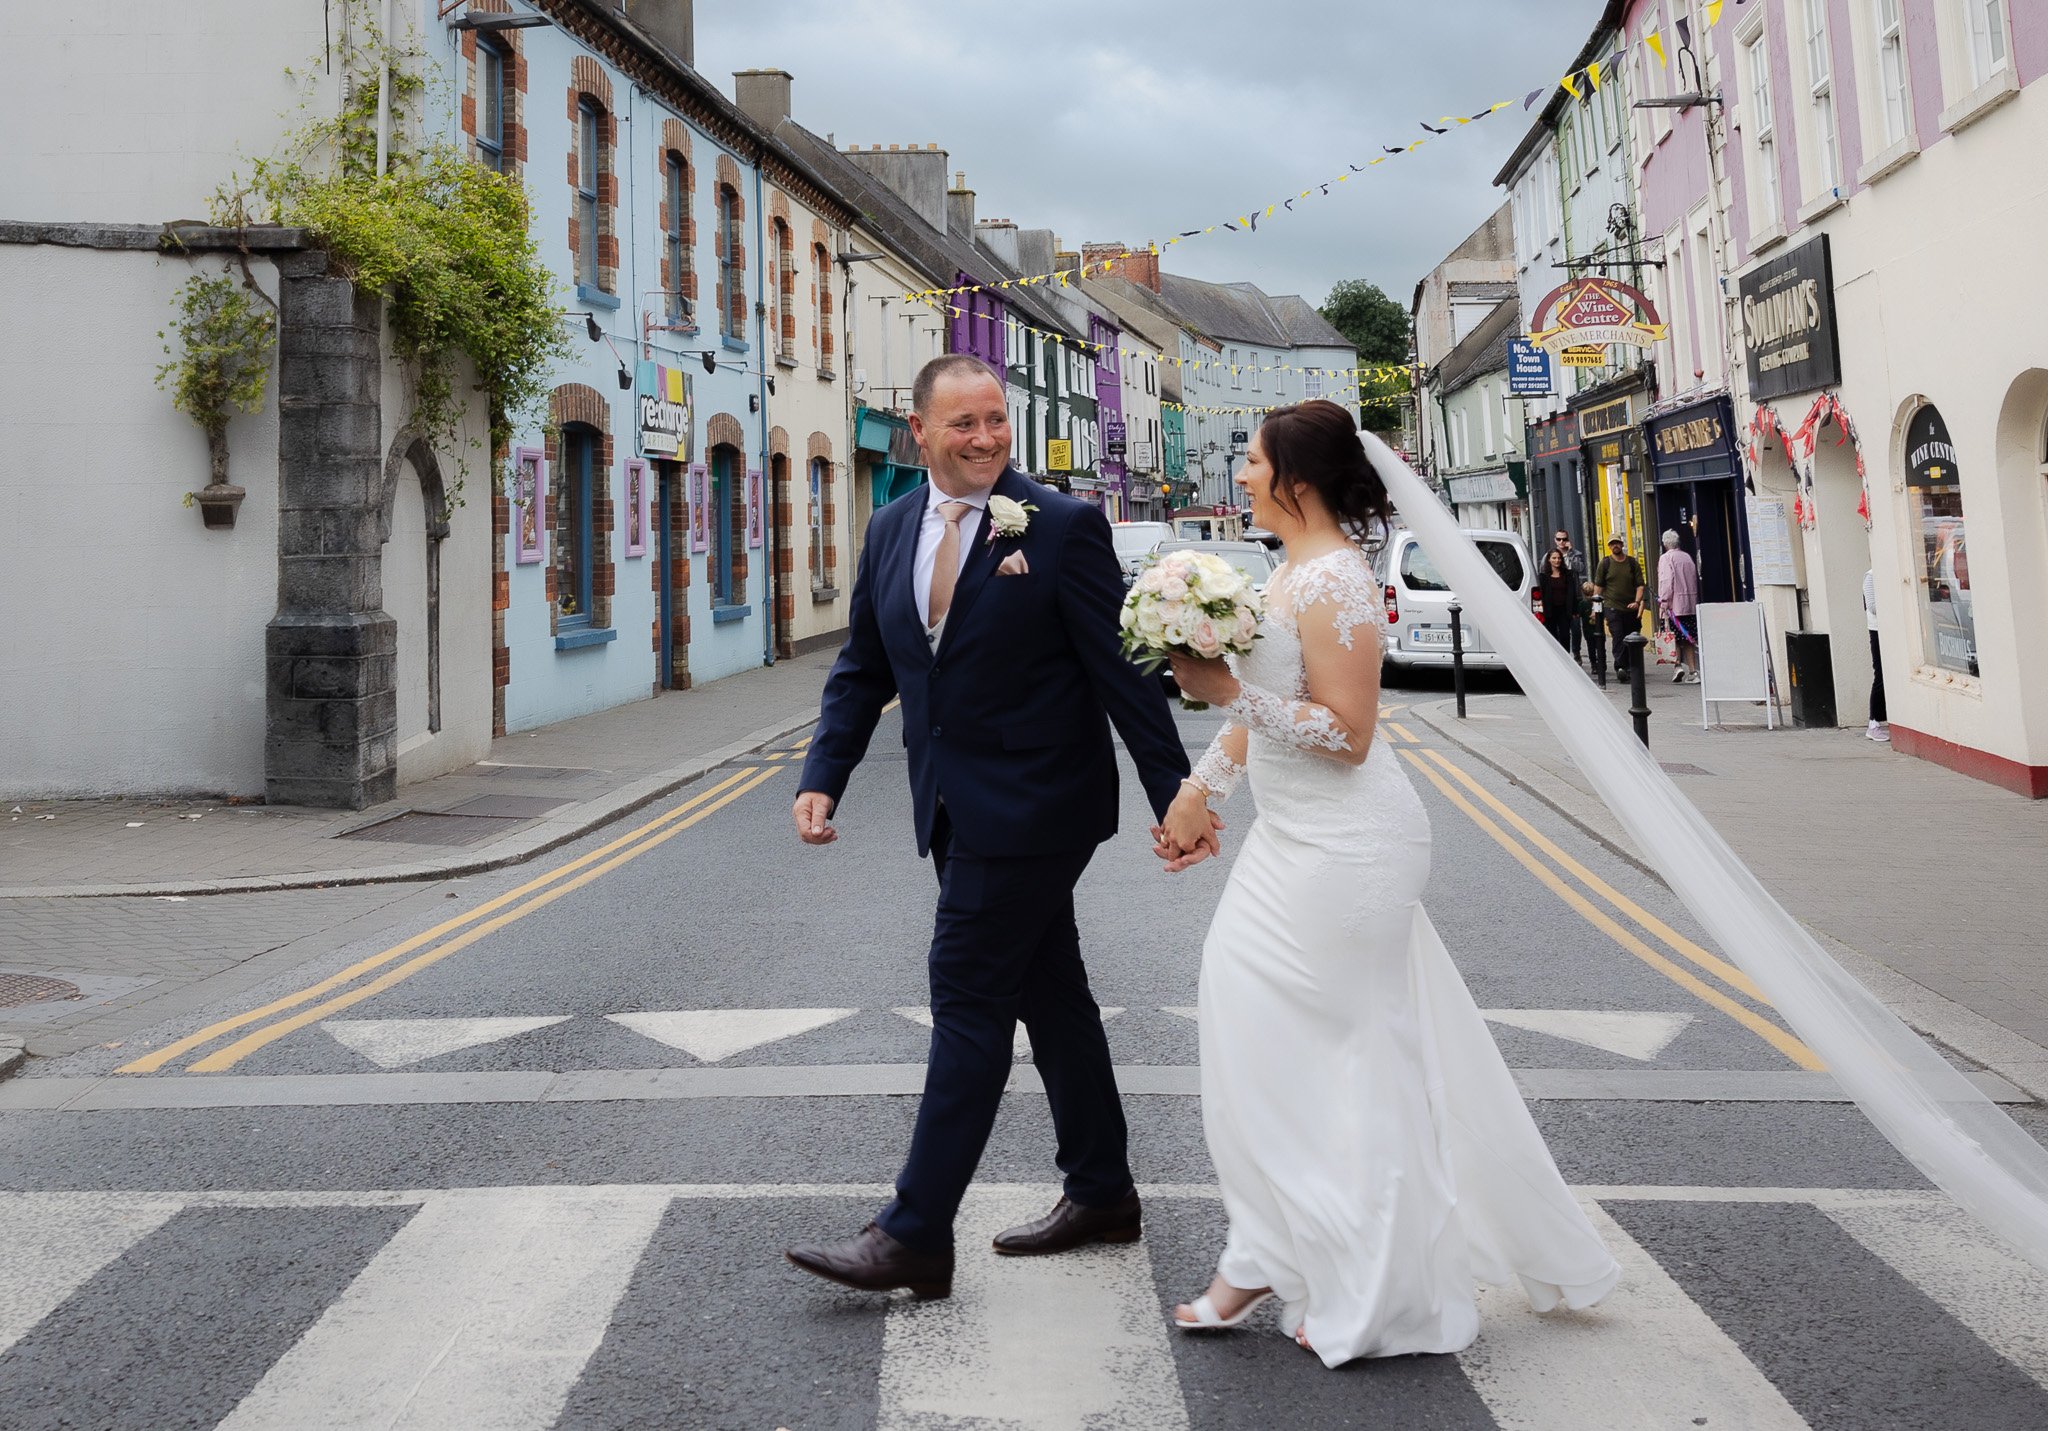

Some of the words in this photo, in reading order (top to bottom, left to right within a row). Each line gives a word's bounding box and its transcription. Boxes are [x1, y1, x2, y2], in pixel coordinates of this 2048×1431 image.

[1602, 280, 1618, 288] 1965
[1576, 301, 1614, 312] Wine
[1571, 313, 1620, 325] Centre
[1744, 279, 1821, 353] SULLIVAN'S
[1549, 332, 1579, 350] WINE
[1580, 328, 1646, 345] MERCHANTS
[1513, 343, 1529, 354] No.
[1568, 345, 1596, 353] SERVIC
[1517, 354, 1541, 364] Town
[1562, 356, 1575, 364] 089
[1516, 364, 1543, 373] House
[1052, 444, 1067, 455] HURLEY
[1911, 443, 1929, 469] WINE
[1930, 441, 1957, 465] CENTR
[1053, 455, 1066, 465] DEPOT
